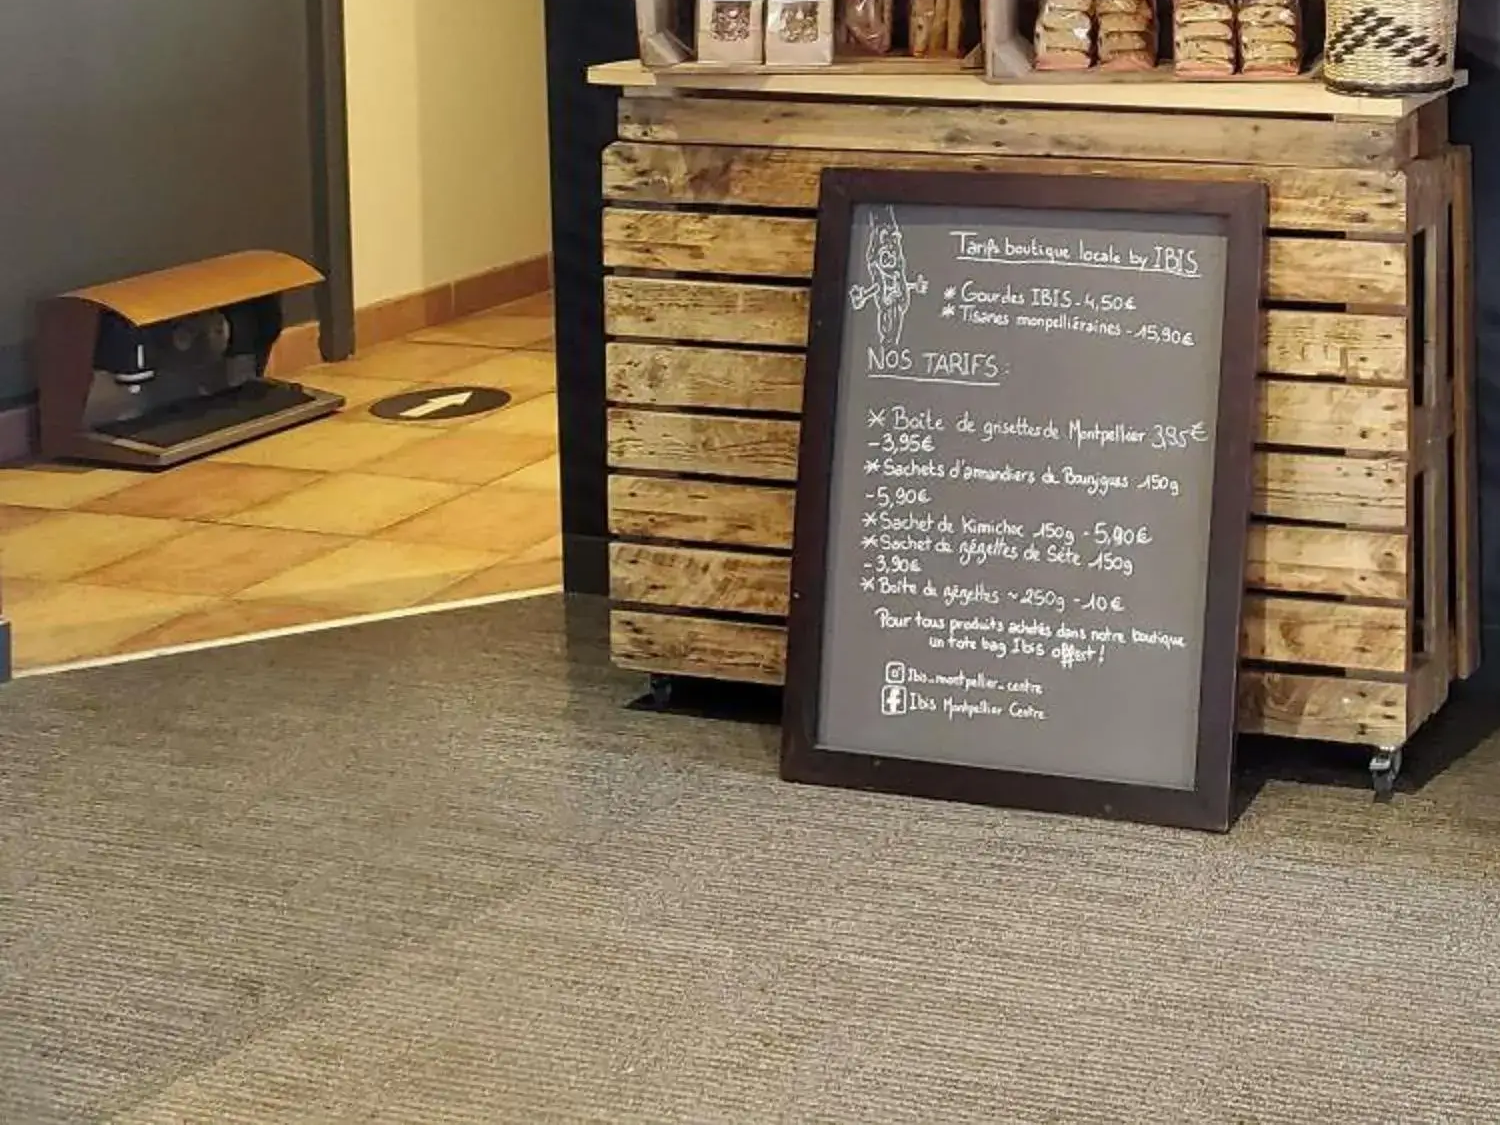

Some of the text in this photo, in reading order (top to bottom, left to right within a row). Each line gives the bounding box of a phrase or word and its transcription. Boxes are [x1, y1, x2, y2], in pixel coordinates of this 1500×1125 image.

[1005, 236, 1071, 263] boutique
[1079, 238, 1121, 264] locale
[1128, 247, 1149, 270] by
[1152, 245, 1200, 274] IBIS
[961, 280, 1025, 306] Gourdes
[1031, 287, 1073, 308] IBIS
[867, 346, 913, 372] NOS
[956, 410, 977, 433] de
[1043, 418, 1061, 441] de
[1068, 417, 1147, 451] Montpellier
[883, 457, 946, 477] Sachets
[1041, 465, 1061, 485] de
[1136, 474, 1180, 496] 150g
[879, 510, 935, 533] Sachet
[937, 514, 955, 534] de
[1032, 522, 1076, 546] 150g
[879, 533, 933, 552] Sachet
[935, 537, 954, 554] de
[1022, 542, 1042, 563] de
[1087, 552, 1135, 576] 150g
[922, 578, 938, 598] de
[873, 606, 912, 629] Pour
[915, 610, 946, 630] tous
[950, 615, 1005, 637] produits
[1056, 622, 1088, 640] dans
[1090, 626, 1127, 644] notre
[1131, 627, 1187, 651] boutique
[928, 635, 945, 649] un
[948, 635, 978, 651] tote
[980, 635, 1008, 659] bag
[1010, 636, 1046, 657] Ibis
[909, 691, 937, 711] Ibis
[1008, 700, 1050, 721] Centre
